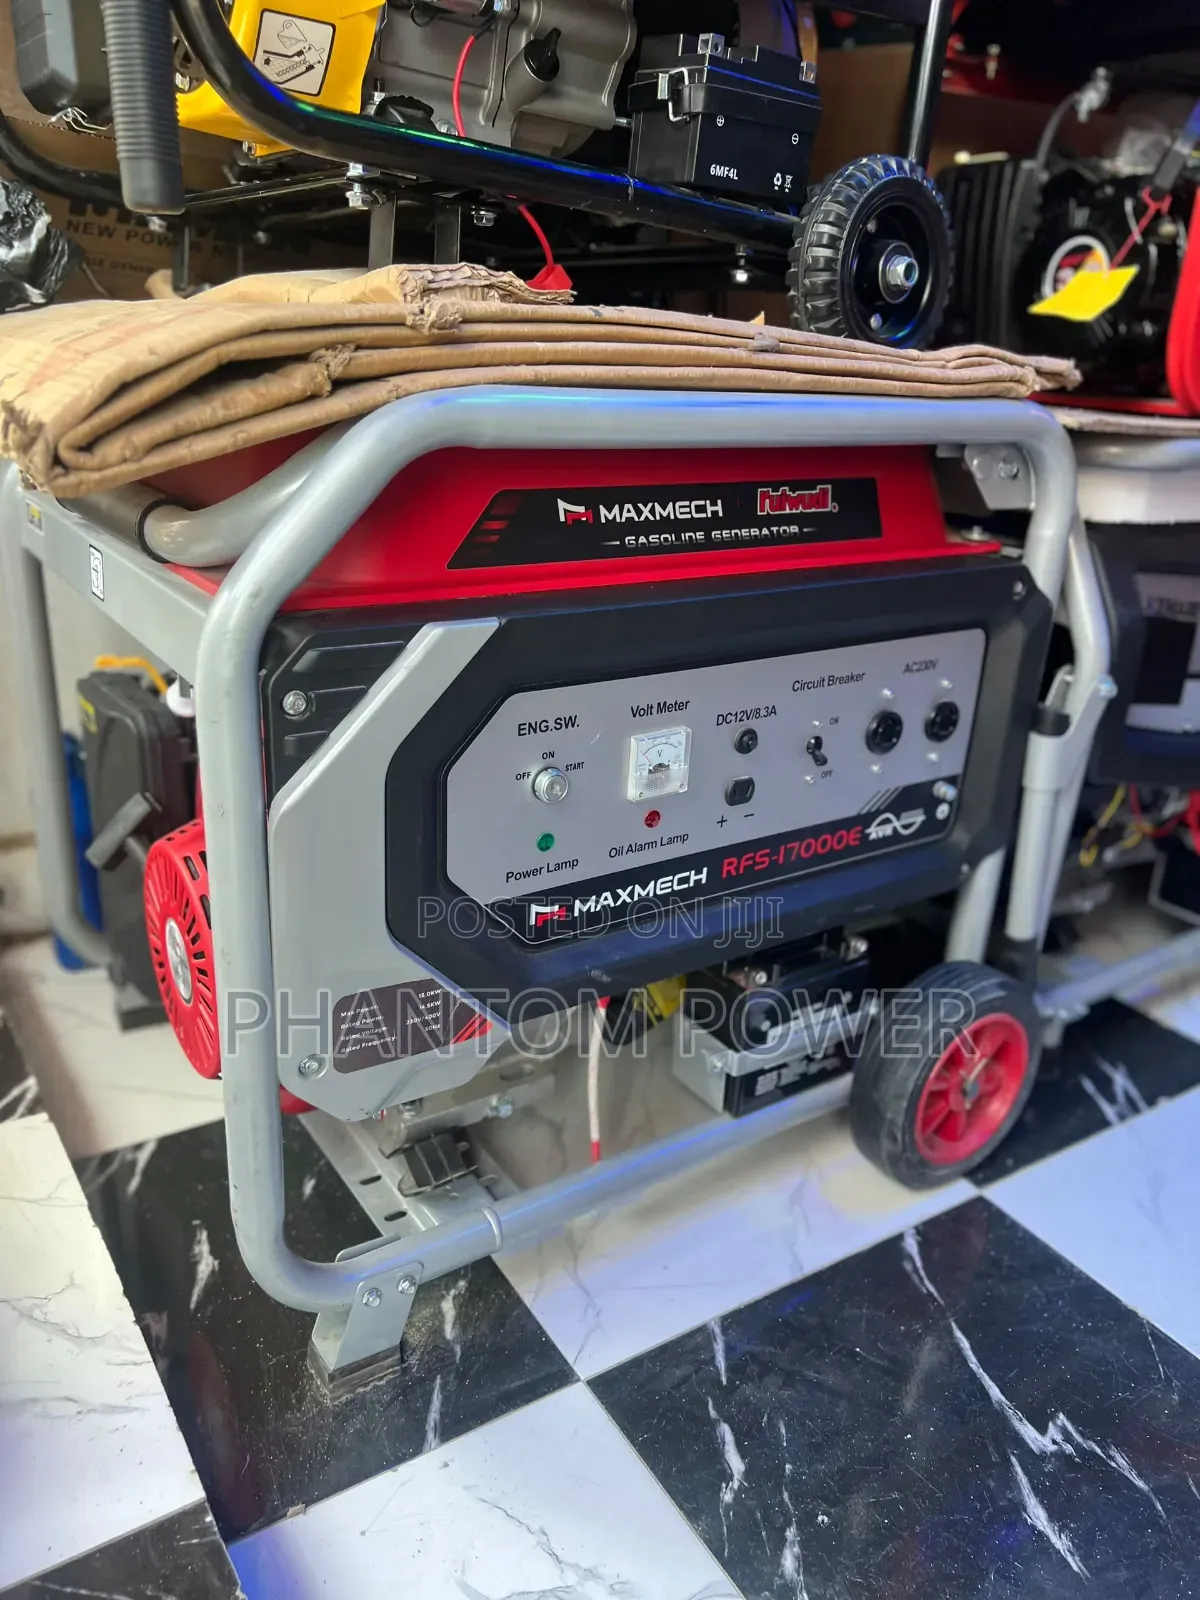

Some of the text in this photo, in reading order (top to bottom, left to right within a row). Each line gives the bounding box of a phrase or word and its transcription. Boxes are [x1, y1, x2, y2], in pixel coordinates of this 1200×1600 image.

[710, 164, 739, 180] 6MF4L
[66, 219, 116, 239] NEW
[599, 499, 724, 523] MAXMECH
[624, 525, 800, 548] GASOLINE GENERATOR
[792, 671, 866, 692] Circuit Breaker
[630, 700, 690, 719] Volt Meter
[716, 705, 778, 726] DC12V/8.3A
[517, 714, 580, 737] ENG.SW.
[829, 716, 840, 726] ON
[541, 751, 555, 760] ON
[515, 761, 585, 781] OFF START
[821, 769, 833, 779] OFF
[608, 833, 689, 859] Oil Alarm Lamp
[505, 857, 579, 883] Power Lamp
[573, 867, 708, 917] MAXMECH
[722, 826, 863, 878] RFS-17000E
